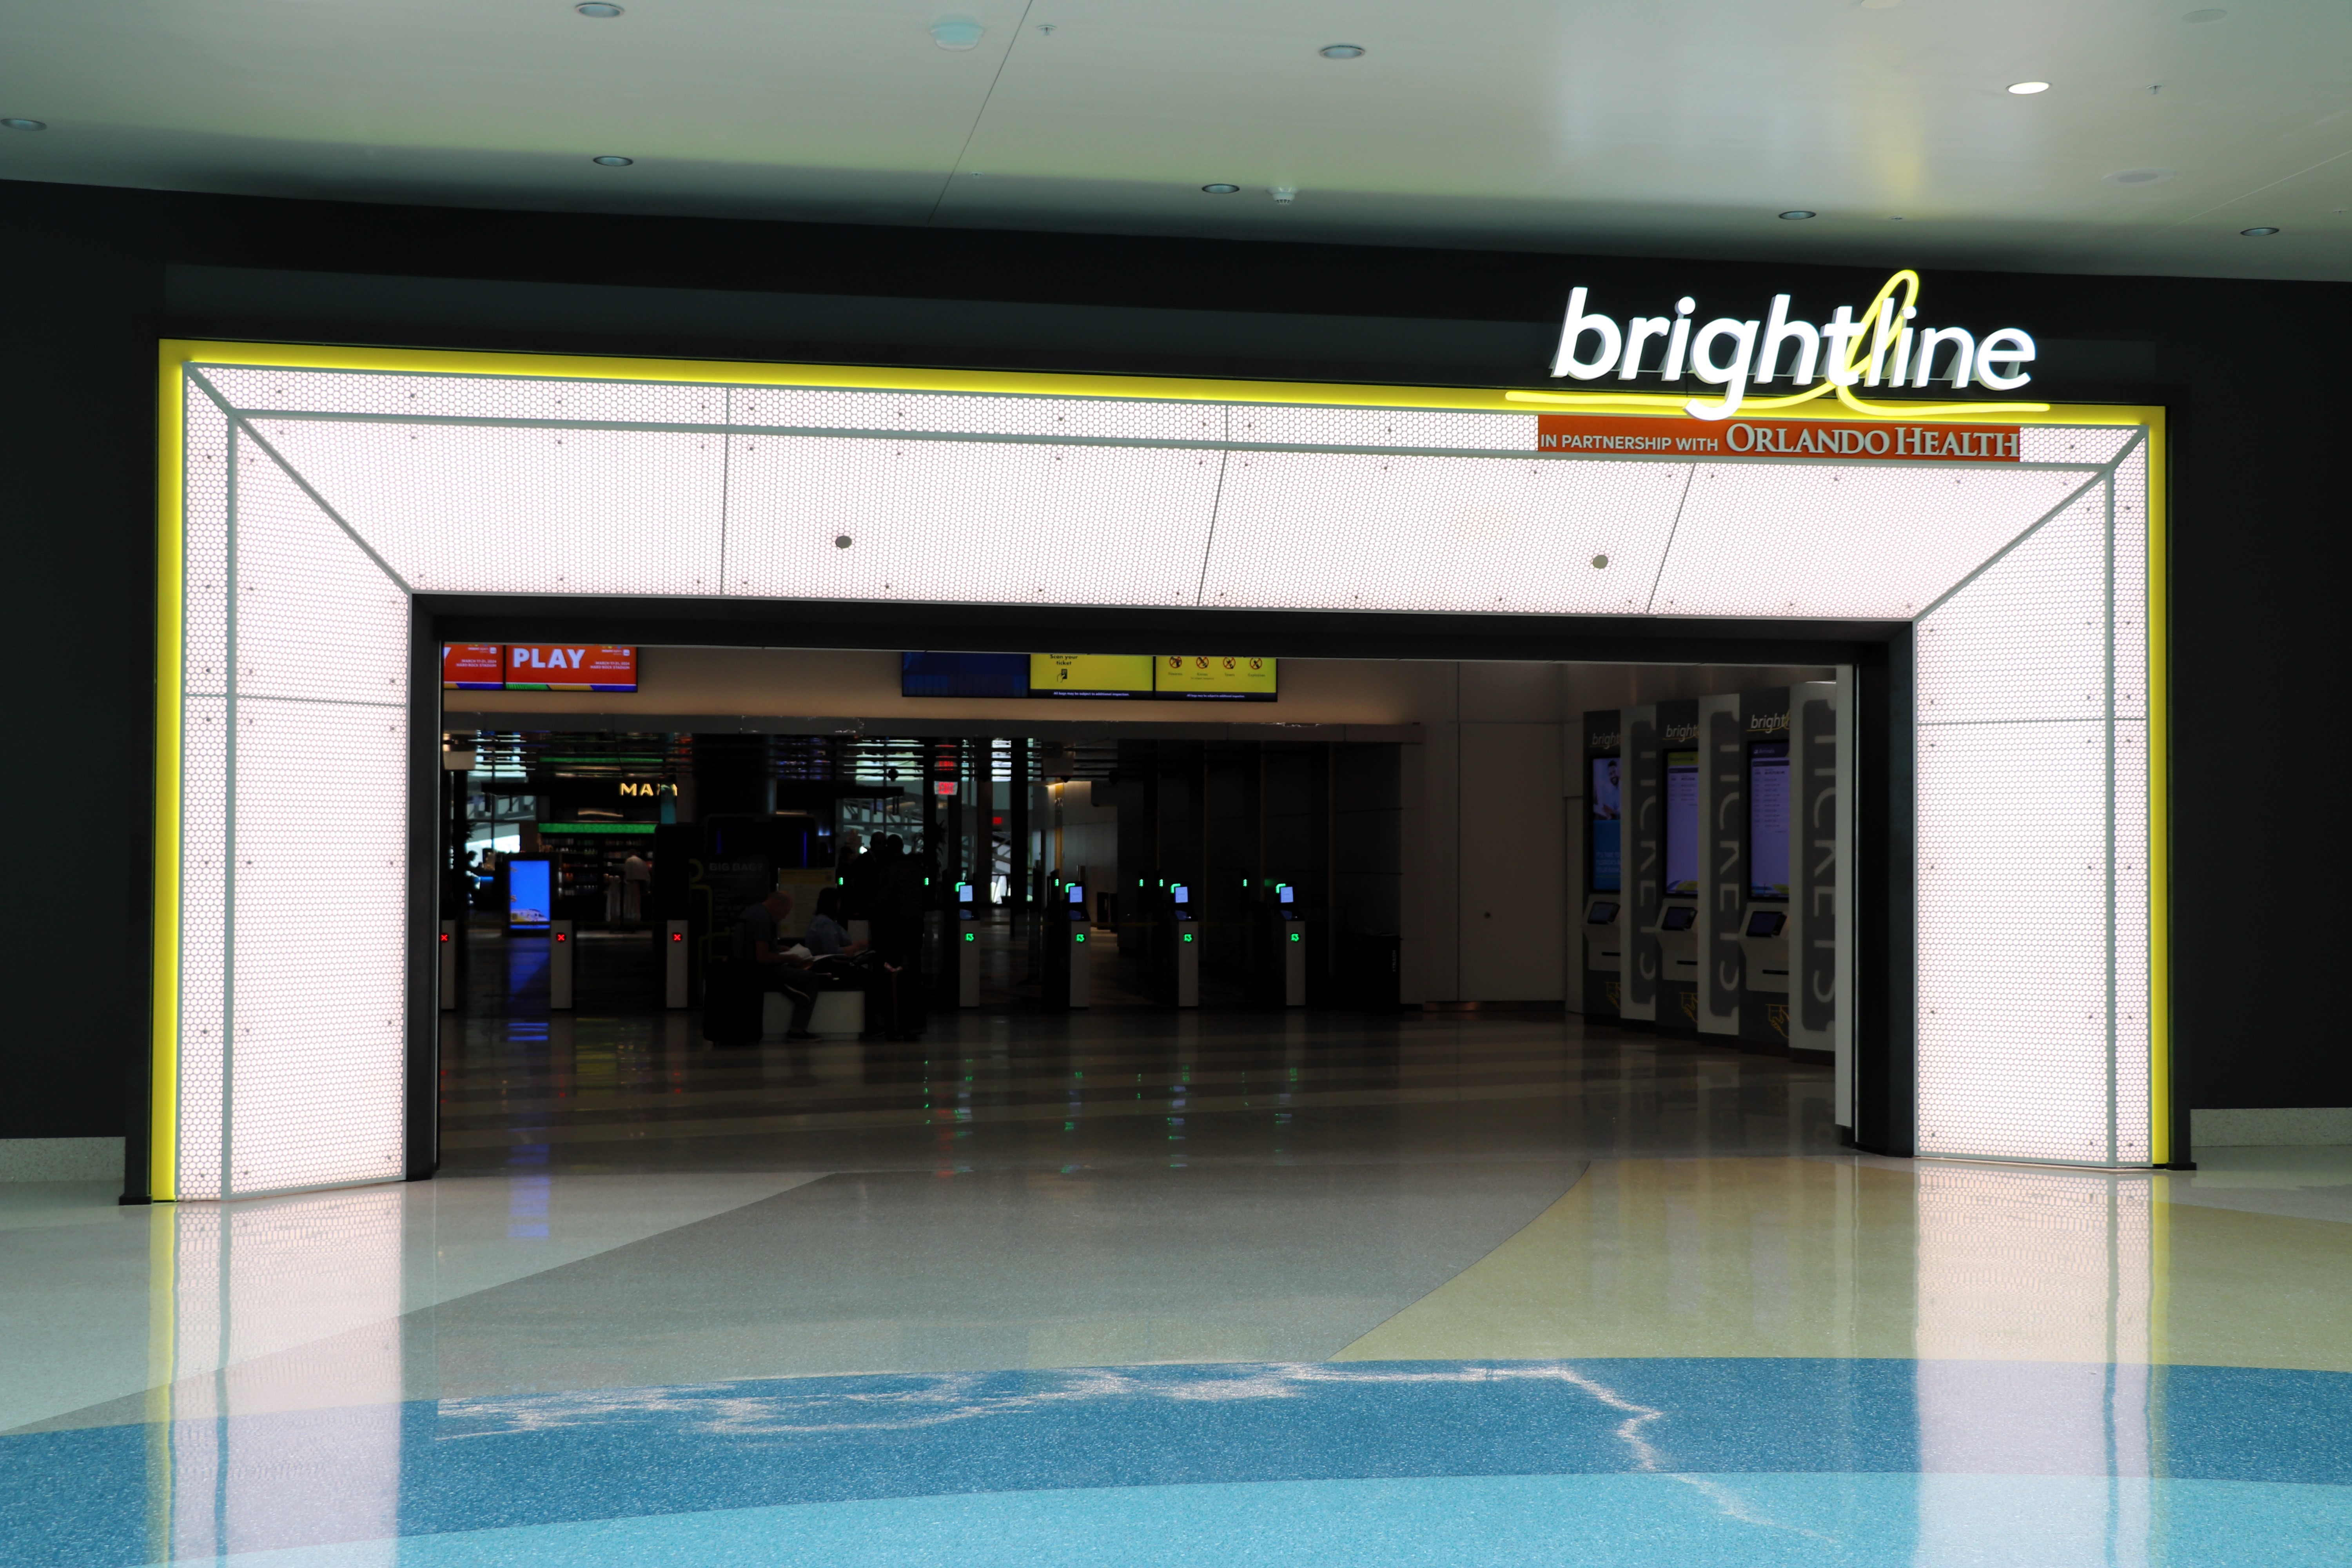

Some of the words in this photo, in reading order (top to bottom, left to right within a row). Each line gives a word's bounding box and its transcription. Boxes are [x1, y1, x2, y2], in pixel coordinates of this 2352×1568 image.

[1550, 285, 2036, 421] brightline
[1541, 434, 1557, 447] IN
[1562, 435, 1672, 450] PARTNERSHIP
[1676, 437, 1719, 451] WITH
[1726, 423, 1890, 455] ORLANDO
[1895, 427, 2020, 457] HEALTH
[513, 648, 586, 668] PLAY
[709, 862, 730, 871] BIG
[732, 862, 764, 872] BAG?
